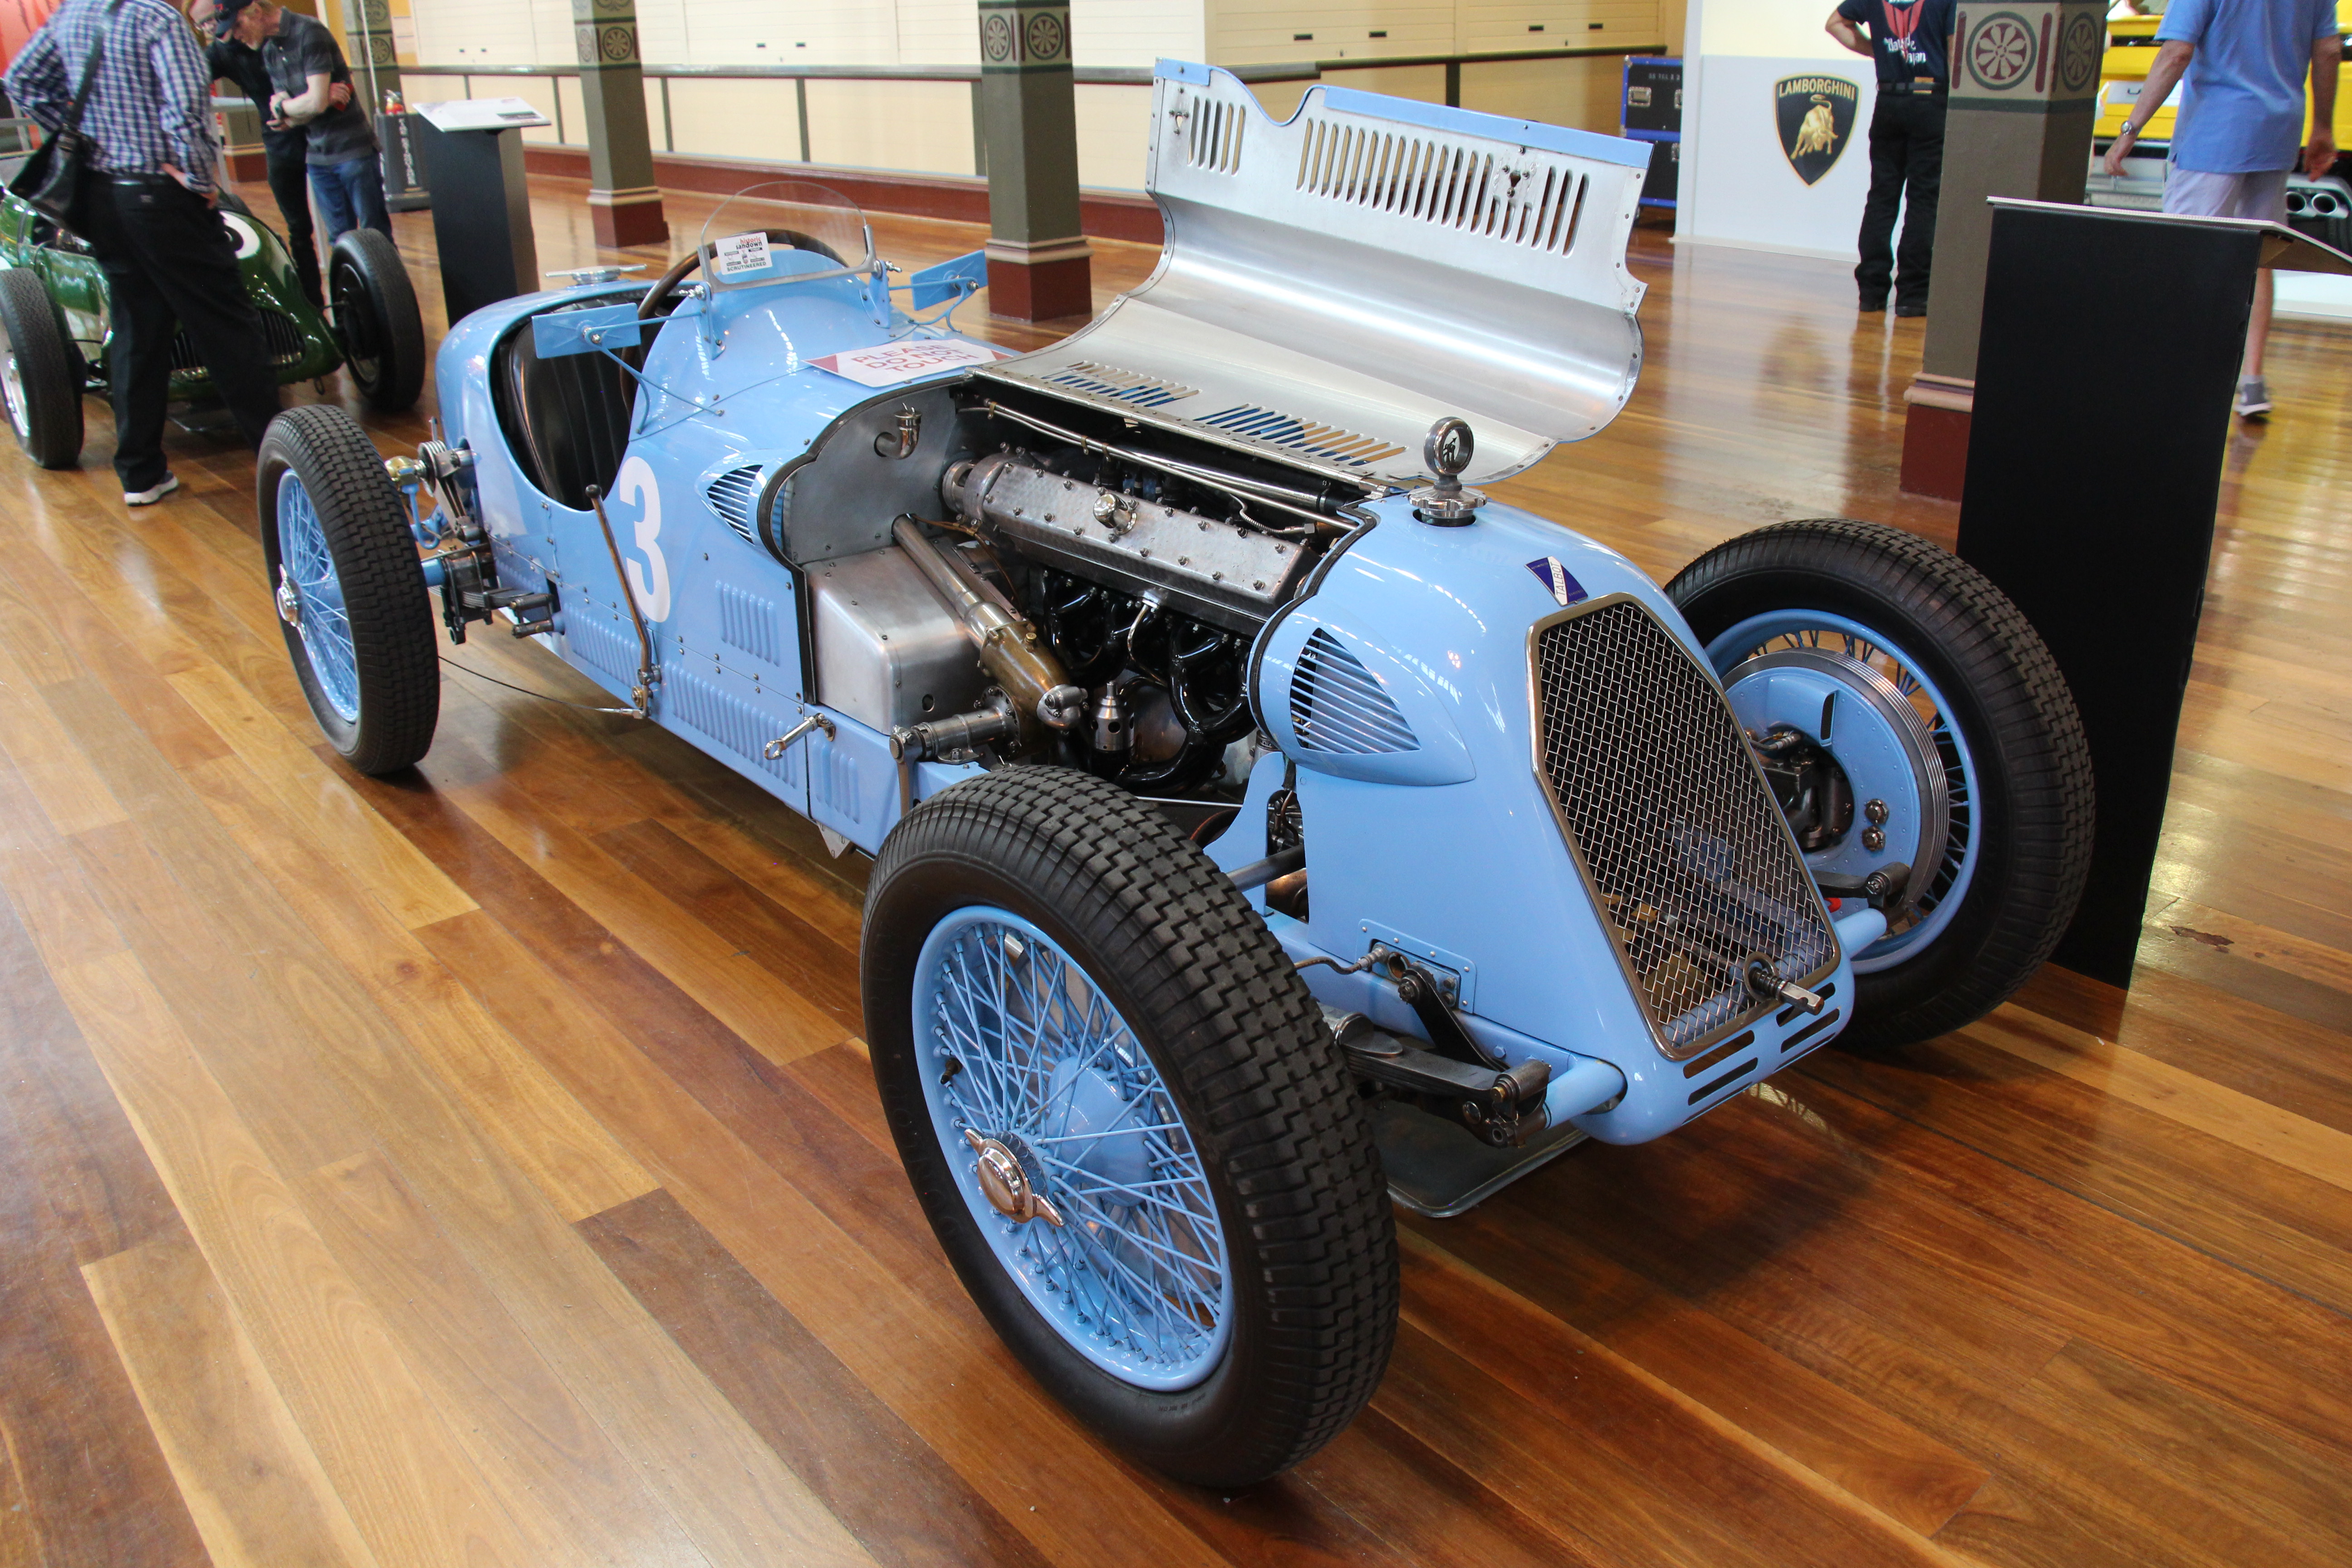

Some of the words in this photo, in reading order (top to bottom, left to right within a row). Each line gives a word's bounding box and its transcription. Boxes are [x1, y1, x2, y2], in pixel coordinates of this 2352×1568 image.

[1779, 78, 1856, 100] LAMBORGHINI
[736, 241, 762, 250] sandown
[740, 236, 761, 244] historic
[726, 261, 766, 272] SCRUTINEERED
[851, 344, 951, 363] PLEASE
[864, 358, 908, 369] DO
[909, 349, 965, 358] NOT
[884, 354, 980, 372] TOUCH
[619, 456, 671, 623] 3
[1550, 561, 1565, 595] TALBOT
